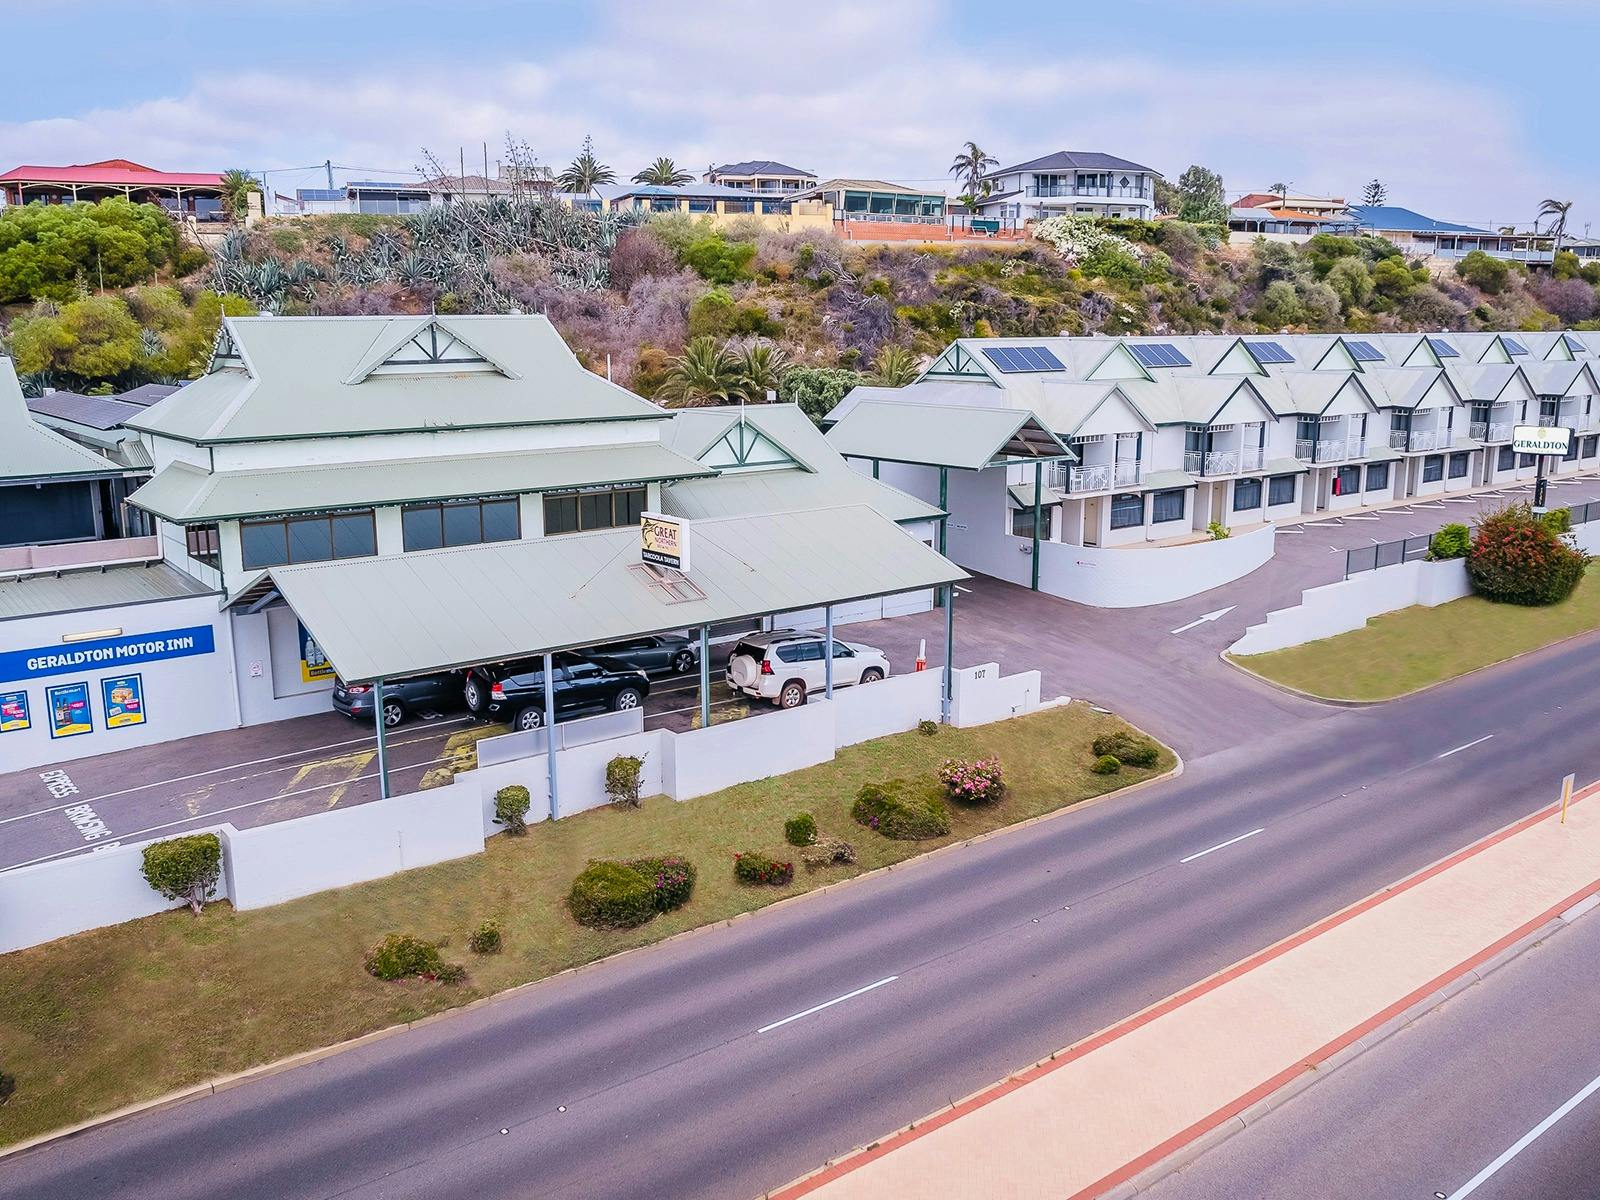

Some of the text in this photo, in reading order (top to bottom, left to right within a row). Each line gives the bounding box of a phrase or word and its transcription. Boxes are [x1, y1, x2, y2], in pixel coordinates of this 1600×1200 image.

[1513, 440, 1568, 450] GERALDTON
[654, 526, 676, 540] GREAT
[27, 636, 194, 671] GERALDTON MOTOR INN
[974, 670, 986, 680] 107
